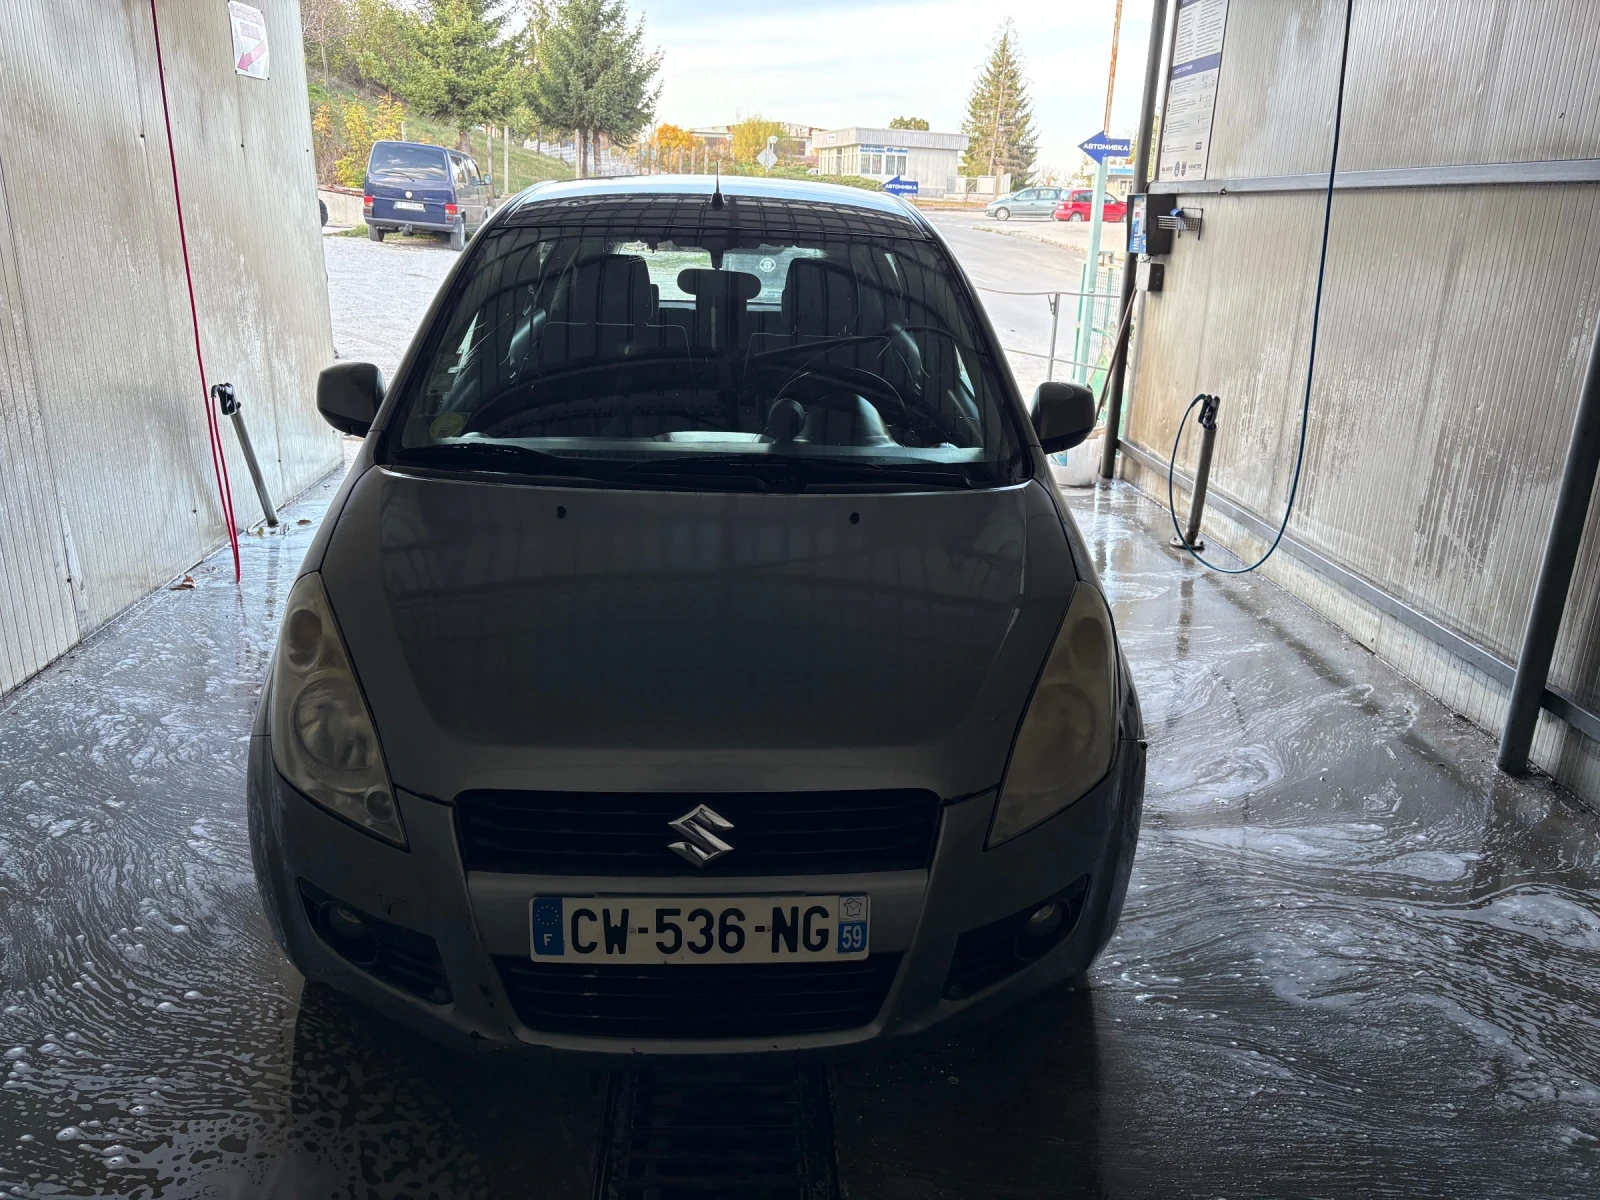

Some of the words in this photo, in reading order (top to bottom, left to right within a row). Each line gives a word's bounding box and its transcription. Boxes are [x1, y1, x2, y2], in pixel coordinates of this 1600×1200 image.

[1083, 143, 1129, 152] АВТОМИВКА
[571, 905, 830, 955] CW-536-NG
[841, 925, 862, 949] 59
[543, 933, 553, 946] F
